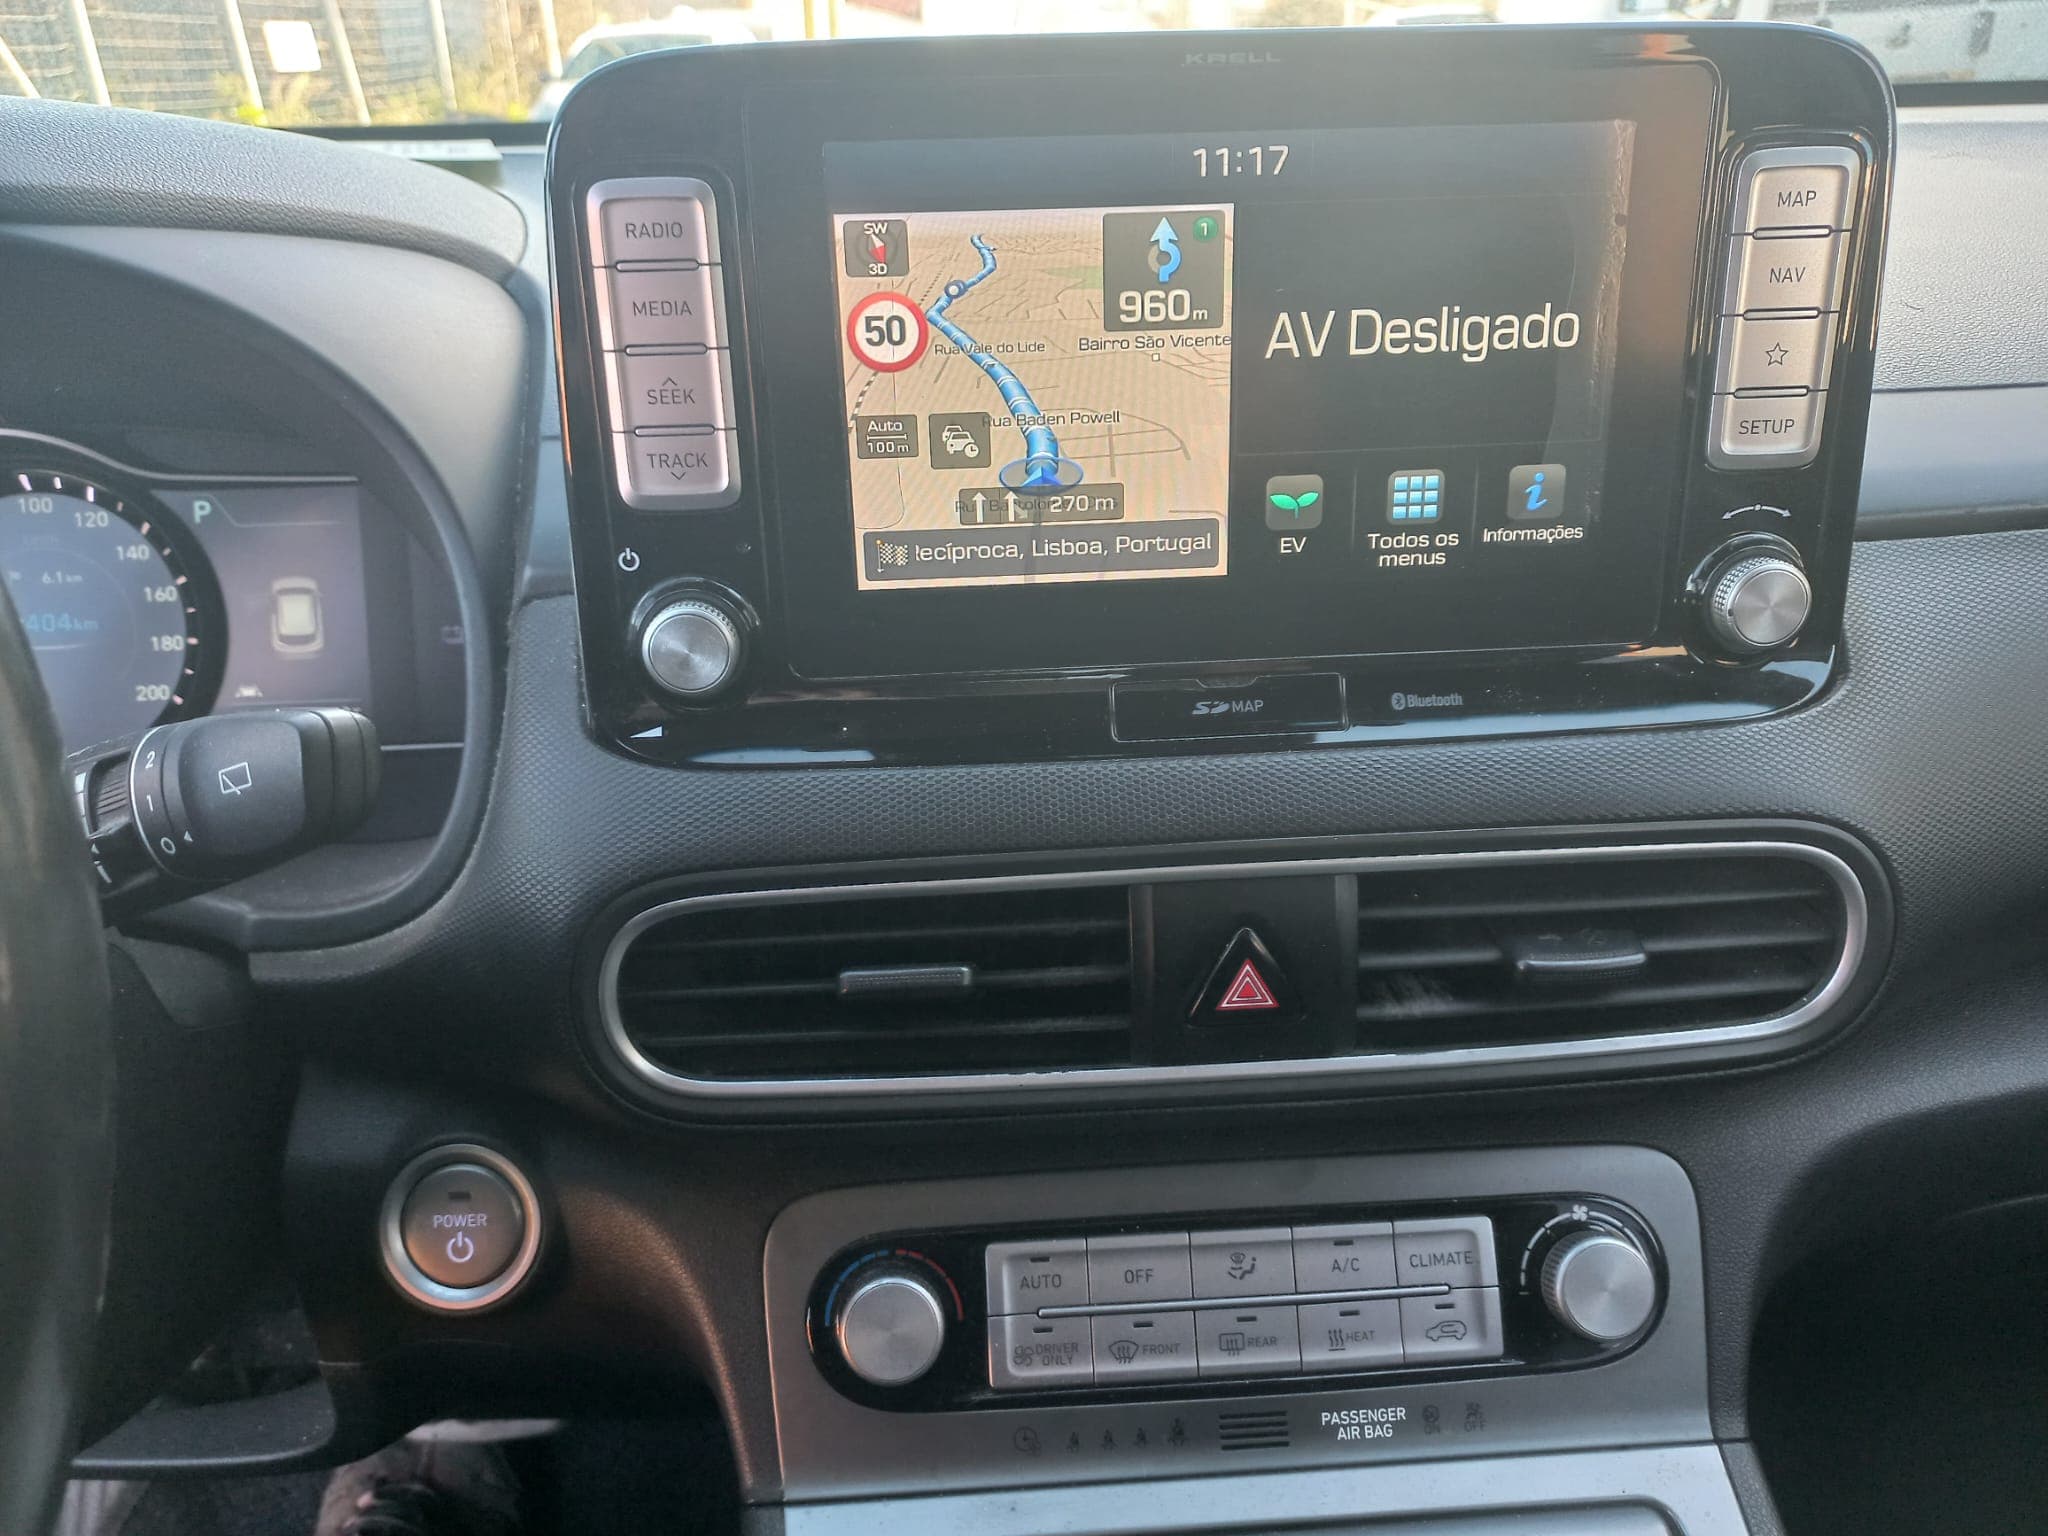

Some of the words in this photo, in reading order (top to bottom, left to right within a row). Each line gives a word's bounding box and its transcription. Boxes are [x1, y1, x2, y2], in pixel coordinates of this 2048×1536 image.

[1185, 51, 1282, 64] KRELL
[1193, 145, 1289, 177] 11:17
[1777, 190, 1817, 207] MAP
[625, 221, 684, 239] RADIO
[863, 222, 888, 235] SW
[1200, 222, 1209, 236] 1
[868, 263, 888, 276] 3D
[1769, 267, 1806, 284] NAV
[632, 300, 693, 317] MEDIA
[864, 314, 907, 347] 50
[1264, 310, 1335, 359] AV
[1349, 302, 1580, 362] Desligado
[934, 344, 961, 356] Rua
[963, 343, 993, 355] Vale
[998, 342, 1014, 354] do
[1017, 341, 1045, 354] Lide
[1078, 336, 1130, 351] Bairro
[1135, 335, 1165, 349] São
[1170, 334, 1233, 348] Vicente
[647, 388, 696, 405] SEEK
[867, 418, 903, 433] Auto
[1016, 413, 1065, 427] Baden
[1070, 410, 1120, 425] Powell
[1738, 418, 1796, 435] SETUP
[867, 441, 895, 454] 100
[646, 452, 709, 469] TRACK
[19, 498, 53, 514] 100
[193, 501, 212, 523] P
[1049, 495, 1089, 513] 270
[1095, 495, 1115, 511] m
[74, 511, 109, 528] 120
[1367, 532, 1430, 550] Todos
[1435, 532, 1460, 546] os
[1483, 524, 1584, 544] Informações
[116, 544, 150, 560] 140
[1032, 537, 1108, 558] Lisboa,
[1115, 532, 1212, 556] Portugal
[1279, 536, 1307, 554] EV
[1378, 551, 1446, 568] menus
[144, 585, 178, 602] 160
[151, 635, 184, 652] 180
[135, 685, 170, 702] 200
[1407, 693, 1464, 708] Bluetooth
[1232, 699, 1264, 713] MAP
[145, 751, 156, 769] 2
[146, 795, 155, 812] 1
[432, 1213, 487, 1229] POWER
[1331, 1256, 1361, 1274] A/C
[1409, 1250, 1473, 1270] CLIMATE
[1019, 1272, 1063, 1290] AUTO
[1124, 1268, 1154, 1284] OFF
[1247, 1335, 1278, 1349] REAR
[1346, 1329, 1375, 1343] HEAT
[1035, 1342, 1079, 1356] DRIVER
[1142, 1343, 1181, 1355] FRONT
[1042, 1354, 1073, 1366] ONLY
[1321, 1407, 1406, 1426] PASSENGER
[1337, 1425, 1361, 1441] AIR
[1364, 1423, 1393, 1439] BAG
